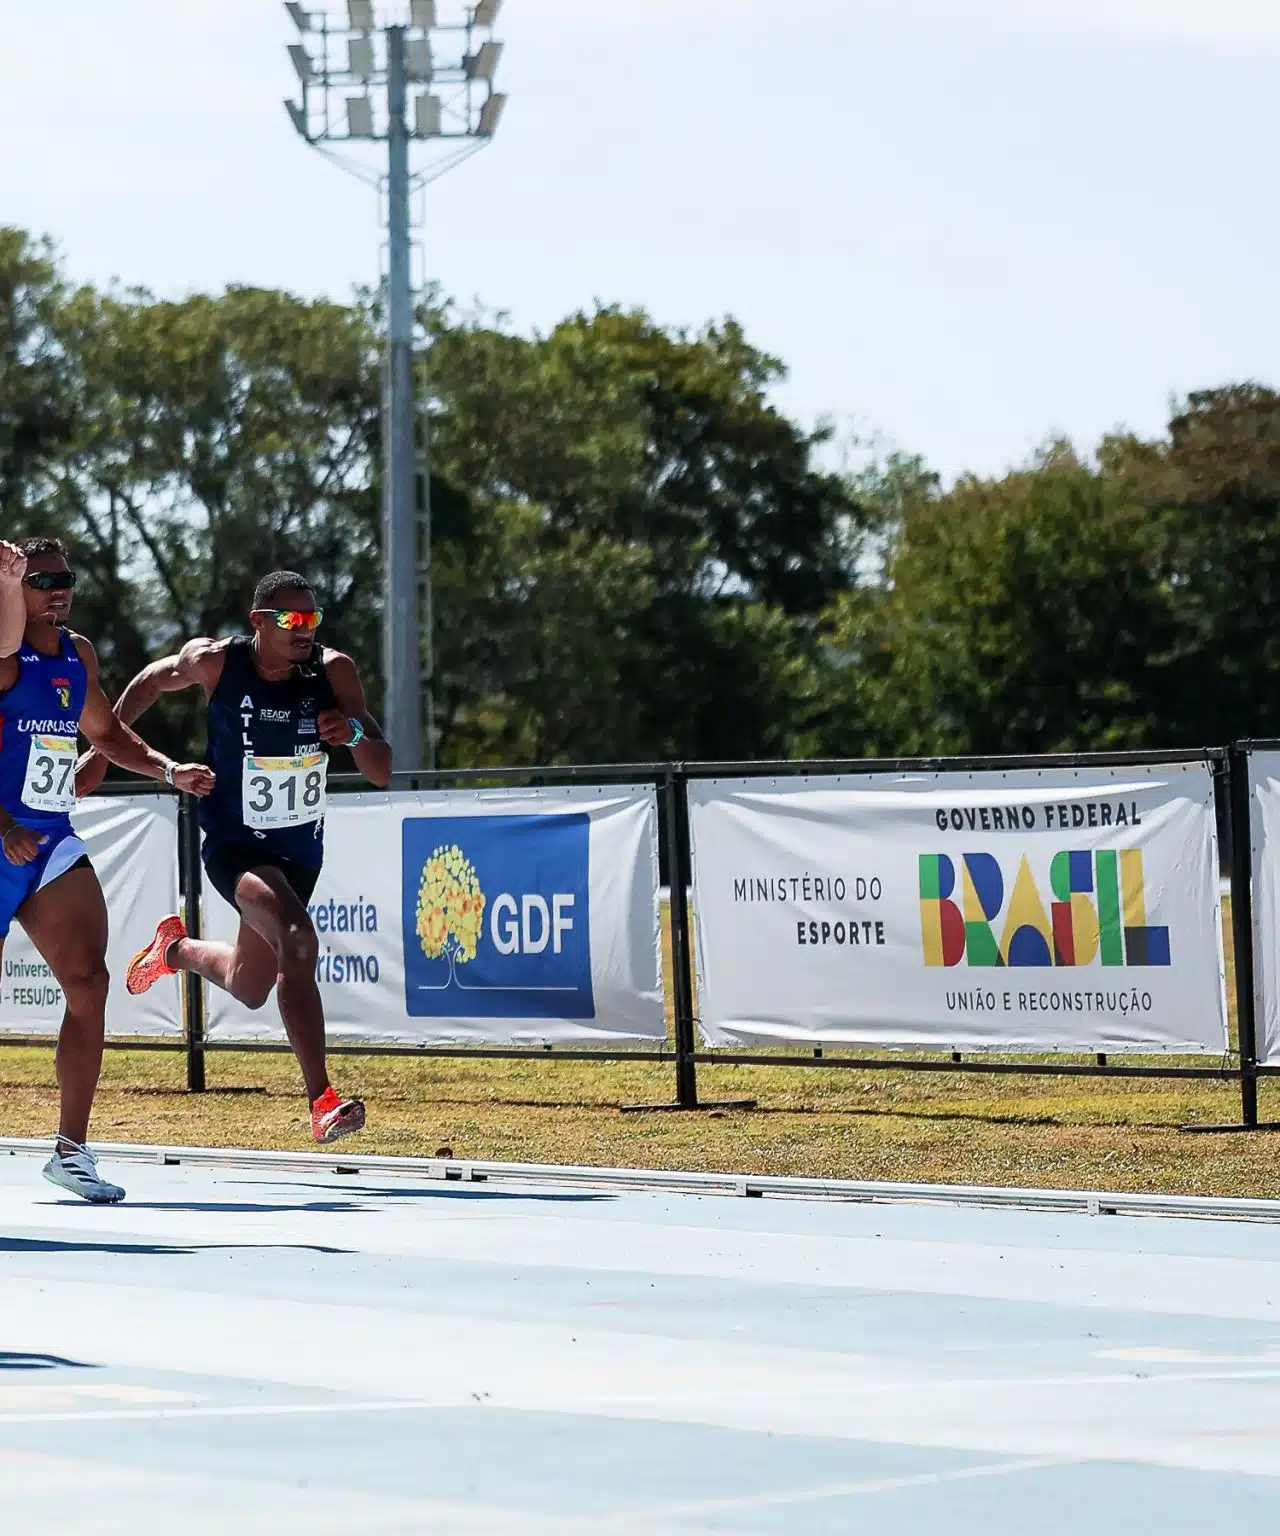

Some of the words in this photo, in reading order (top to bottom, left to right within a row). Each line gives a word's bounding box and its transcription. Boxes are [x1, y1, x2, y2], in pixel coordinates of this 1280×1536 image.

[260, 709, 291, 719] READY
[31, 756, 77, 797] 37
[249, 771, 321, 812] 318
[935, 805, 1036, 831] GOVERNO
[1045, 802, 1141, 828] FEDERAL
[733, 873, 846, 902] MINISTÉRIO
[856, 877, 882, 901] DO
[919, 848, 1171, 967] BRASIL
[491, 893, 575, 955] GDF
[797, 921, 885, 945] ESPORTE
[5, 958, 55, 977] Universi
[14, 988, 62, 1007] FESU/DF
[946, 987, 996, 1011] UNIÃO
[1003, 992, 1011, 1010] E
[1019, 987, 1152, 1016] RECONSTRUÇÃO
